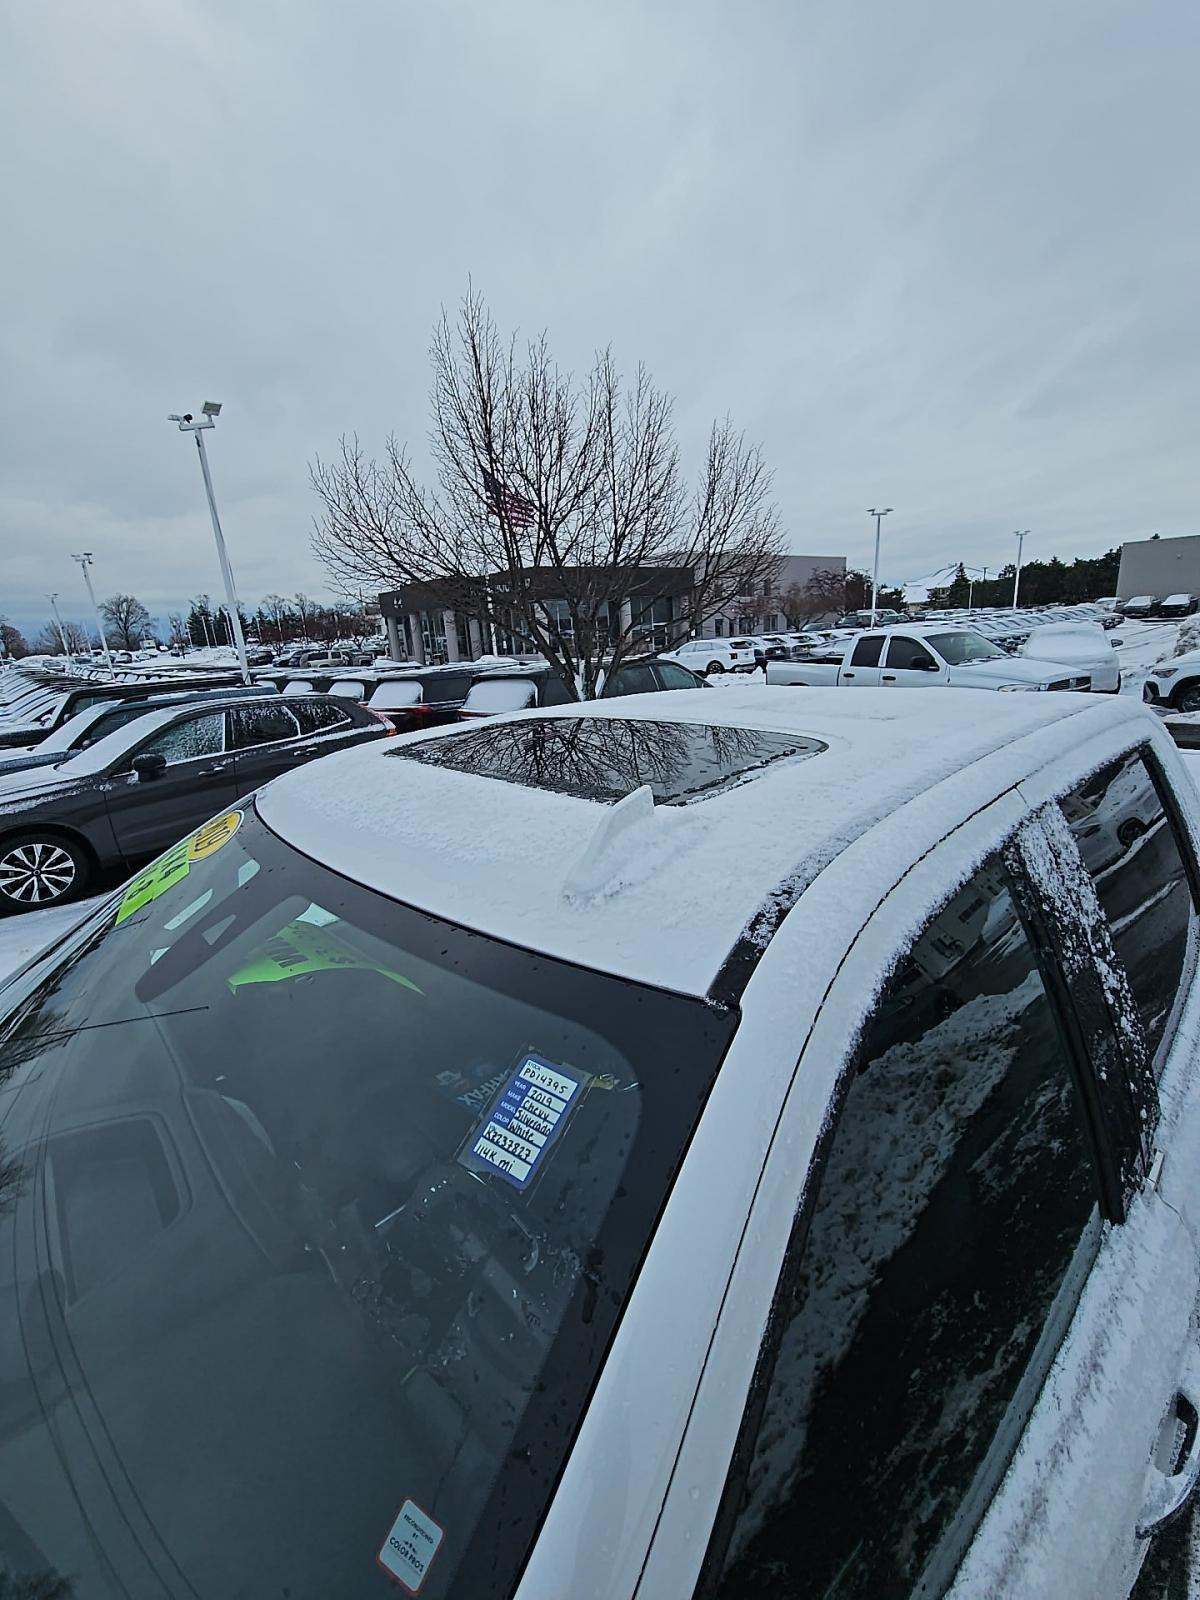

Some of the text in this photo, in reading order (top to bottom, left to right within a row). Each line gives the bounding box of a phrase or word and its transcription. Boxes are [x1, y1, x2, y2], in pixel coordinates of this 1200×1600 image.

[523, 1067, 569, 1094] PD14395
[530, 1089, 553, 1107] 2019
[523, 1100, 550, 1121] Chevy
[508, 1121, 535, 1142] White
[476, 1144, 516, 1173] 114K mi
